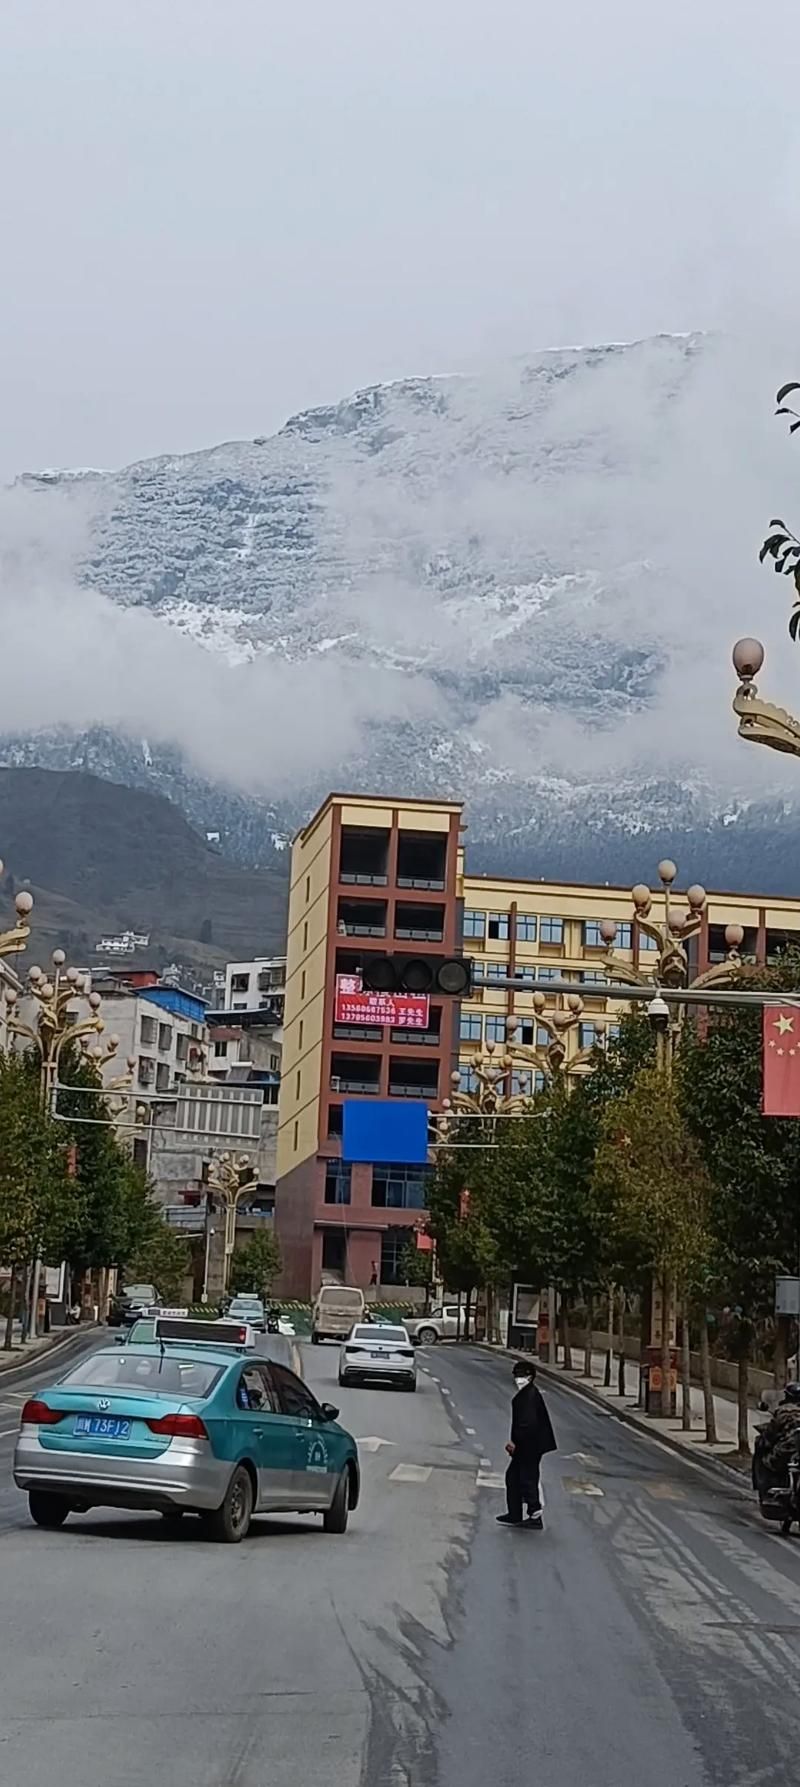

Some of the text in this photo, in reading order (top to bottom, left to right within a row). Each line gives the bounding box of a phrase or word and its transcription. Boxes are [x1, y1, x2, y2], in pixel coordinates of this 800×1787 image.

[369, 997, 395, 1007] 联系人
[398, 1008, 423, 1017] 王先生
